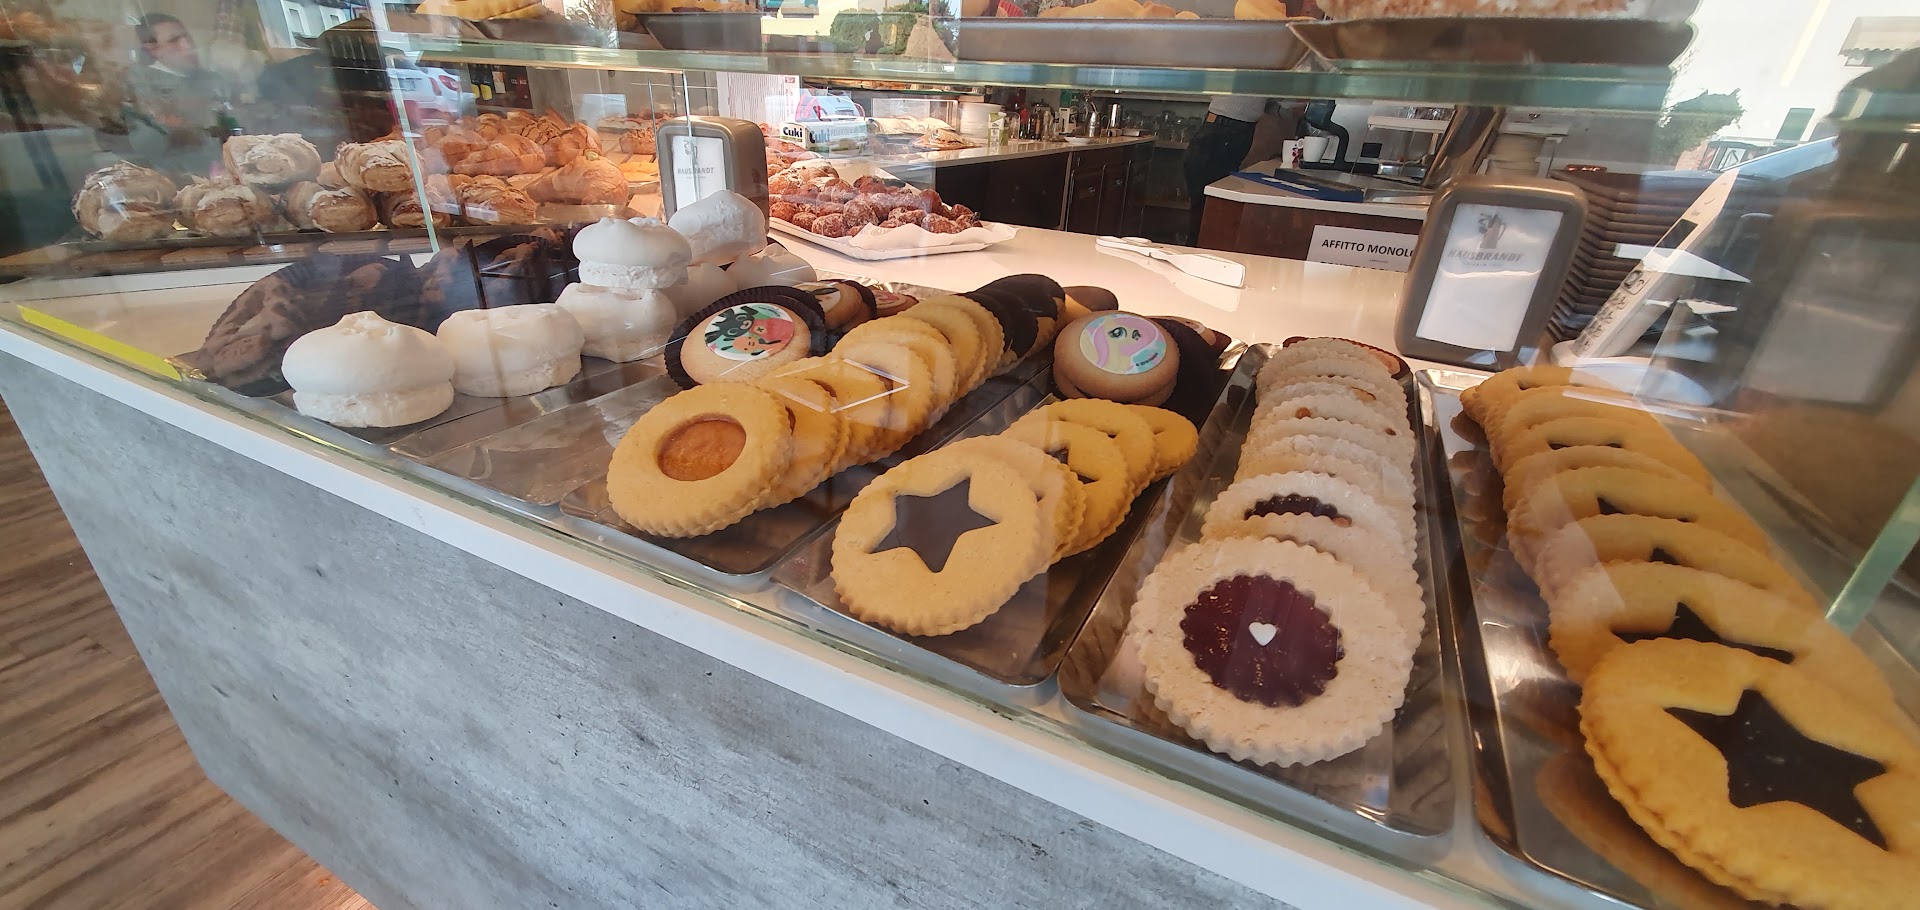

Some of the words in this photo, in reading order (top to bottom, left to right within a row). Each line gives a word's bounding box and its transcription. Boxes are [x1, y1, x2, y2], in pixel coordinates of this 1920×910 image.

[783, 126, 803, 138] Cuki
[809, 127, 830, 143] Cuki
[677, 167, 715, 175] HAUSRANDT
[1321, 239, 1365, 252] AFFITTO
[1446, 249, 1523, 262] HAUSBRANDT
